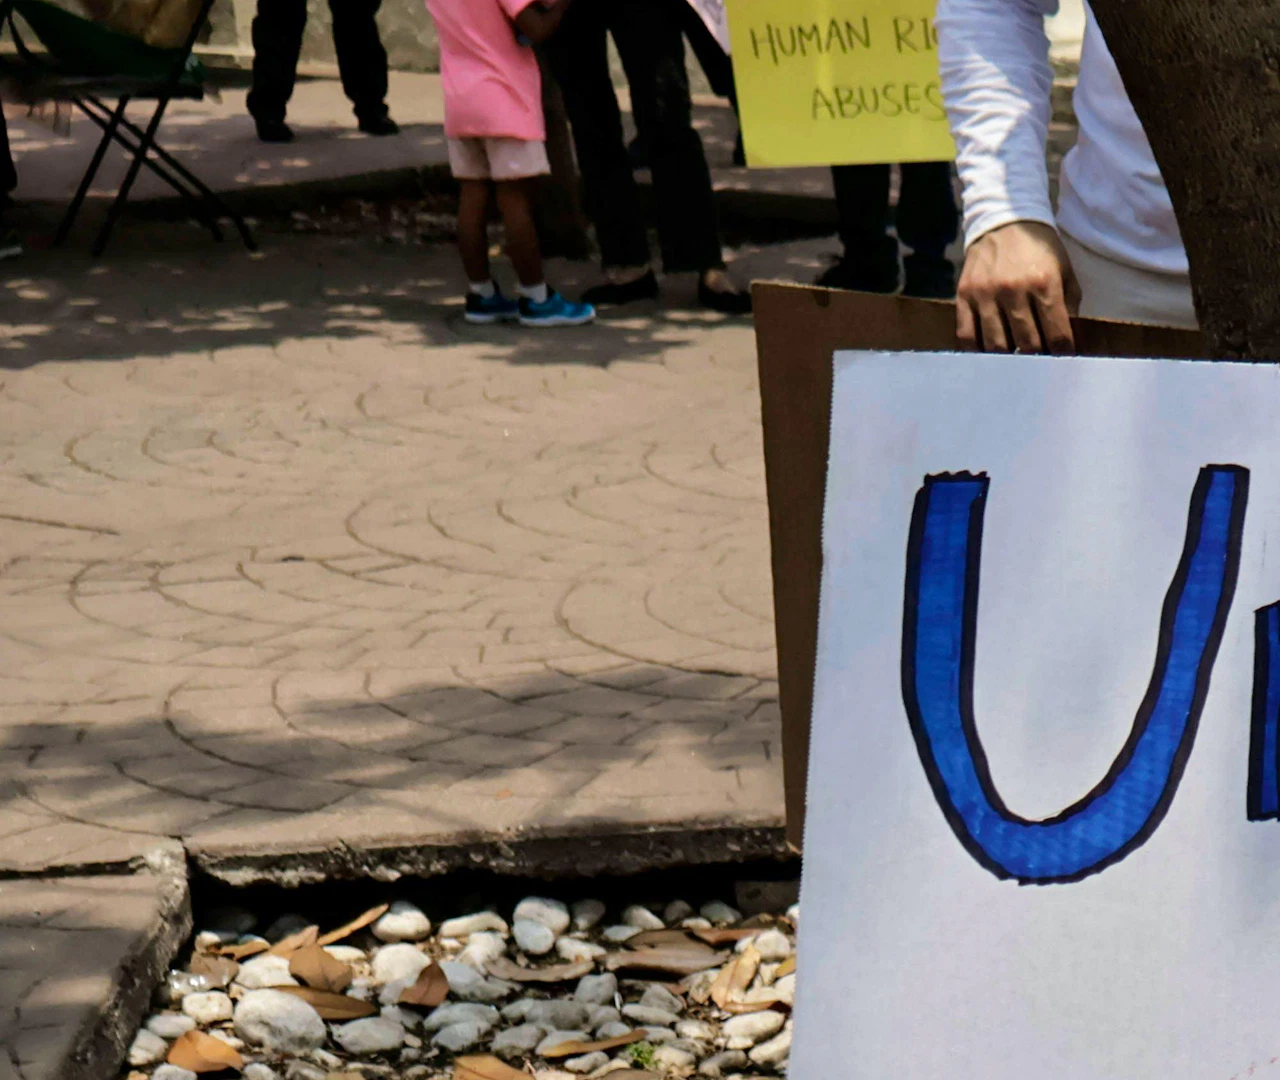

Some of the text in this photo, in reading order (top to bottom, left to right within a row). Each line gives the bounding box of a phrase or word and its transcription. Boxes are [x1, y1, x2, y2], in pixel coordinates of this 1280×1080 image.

[750, 17, 939, 65] HUMAN RI
[811, 82, 946, 121] ABUSES
